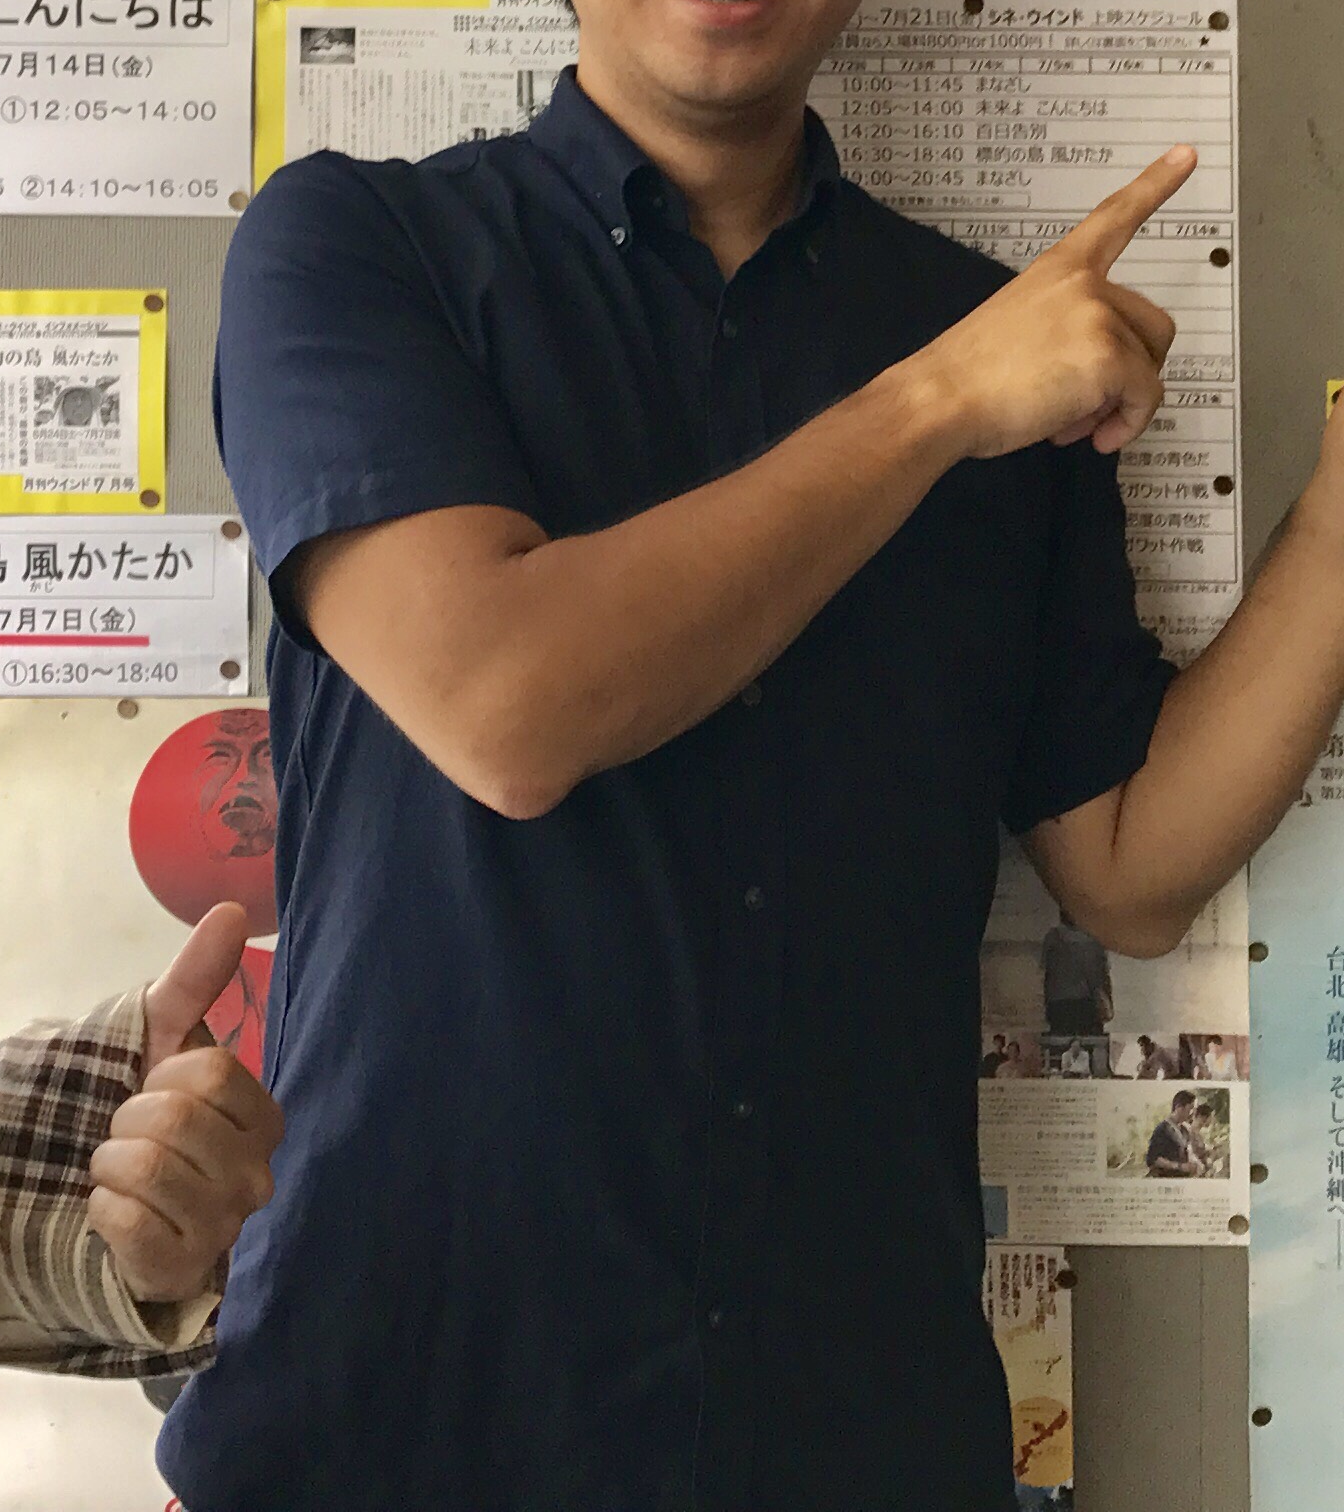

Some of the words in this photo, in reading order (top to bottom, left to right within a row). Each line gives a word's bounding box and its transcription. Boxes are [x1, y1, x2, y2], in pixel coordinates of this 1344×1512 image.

[0, 99, 218, 124] ①12:05～14:00
[20, 174, 219, 201] ②14:10～16:05
[24, 476, 90, 491] 月刊ウインド
[21, 541, 194, 583] 風かたか
[2, 661, 179, 686] ①16:30～18:40
